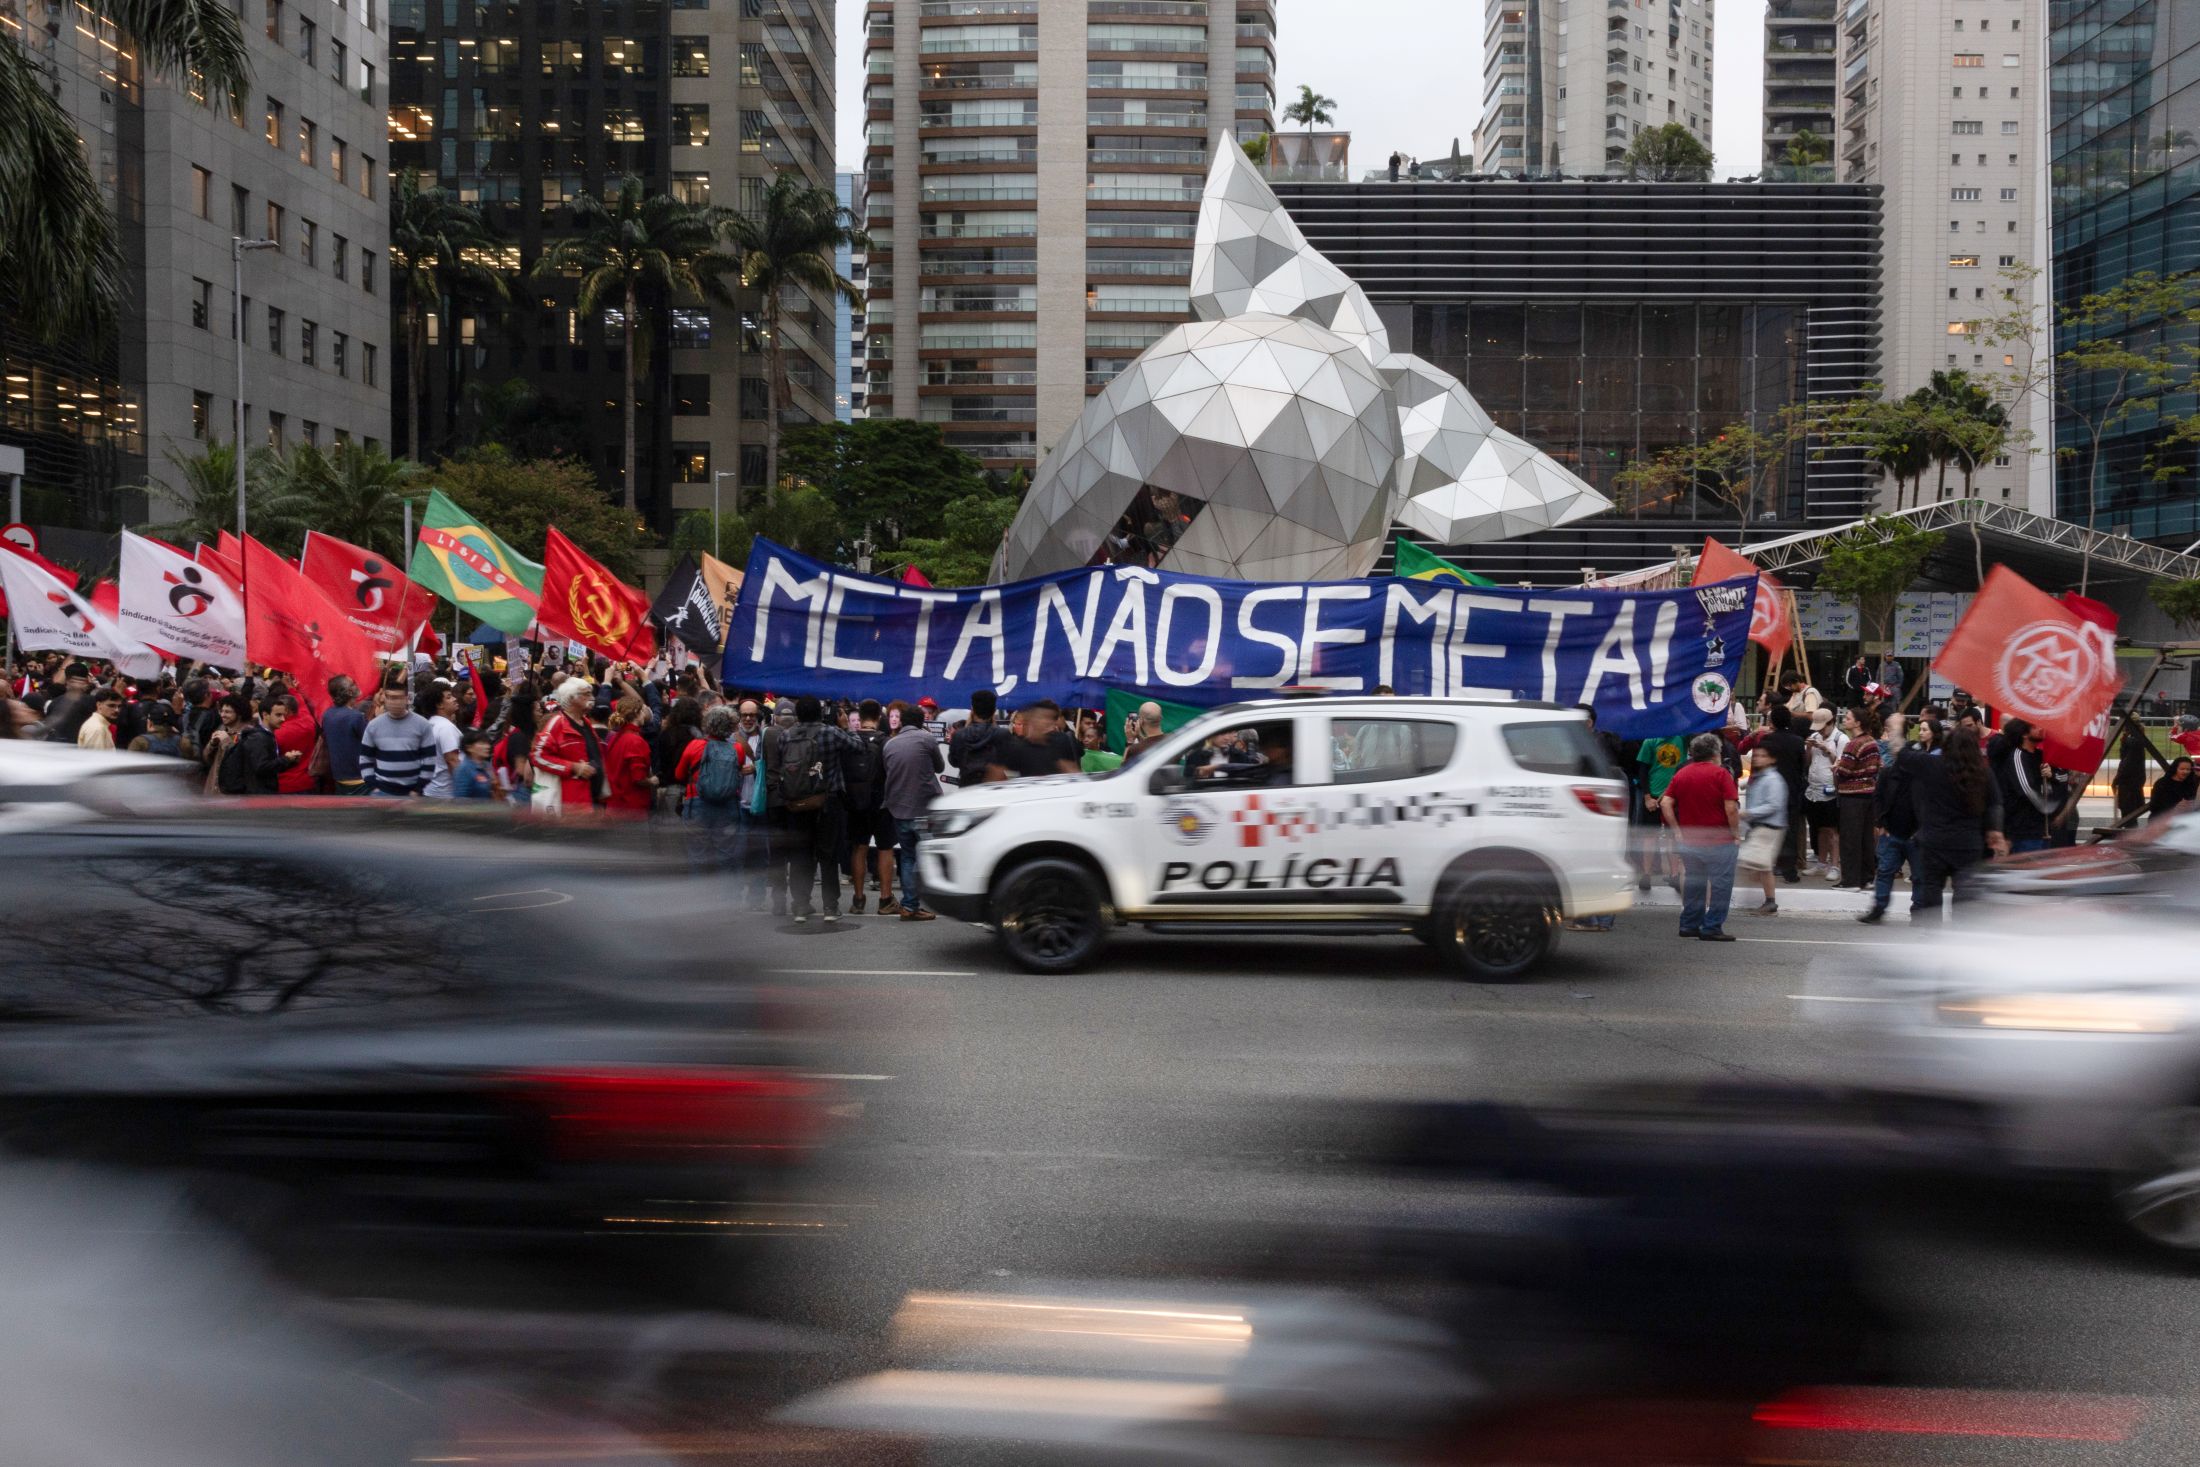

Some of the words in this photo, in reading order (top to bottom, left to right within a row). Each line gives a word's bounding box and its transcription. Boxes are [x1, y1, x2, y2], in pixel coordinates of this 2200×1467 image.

[120, 608, 158, 624] Sindicato
[751, 556, 1018, 696] META,
[1026, 565, 1223, 687] NÃO
[1231, 585, 1371, 690] SE
[1379, 583, 1679, 710] META!
[1158, 852, 1406, 891] POLÍCIA
